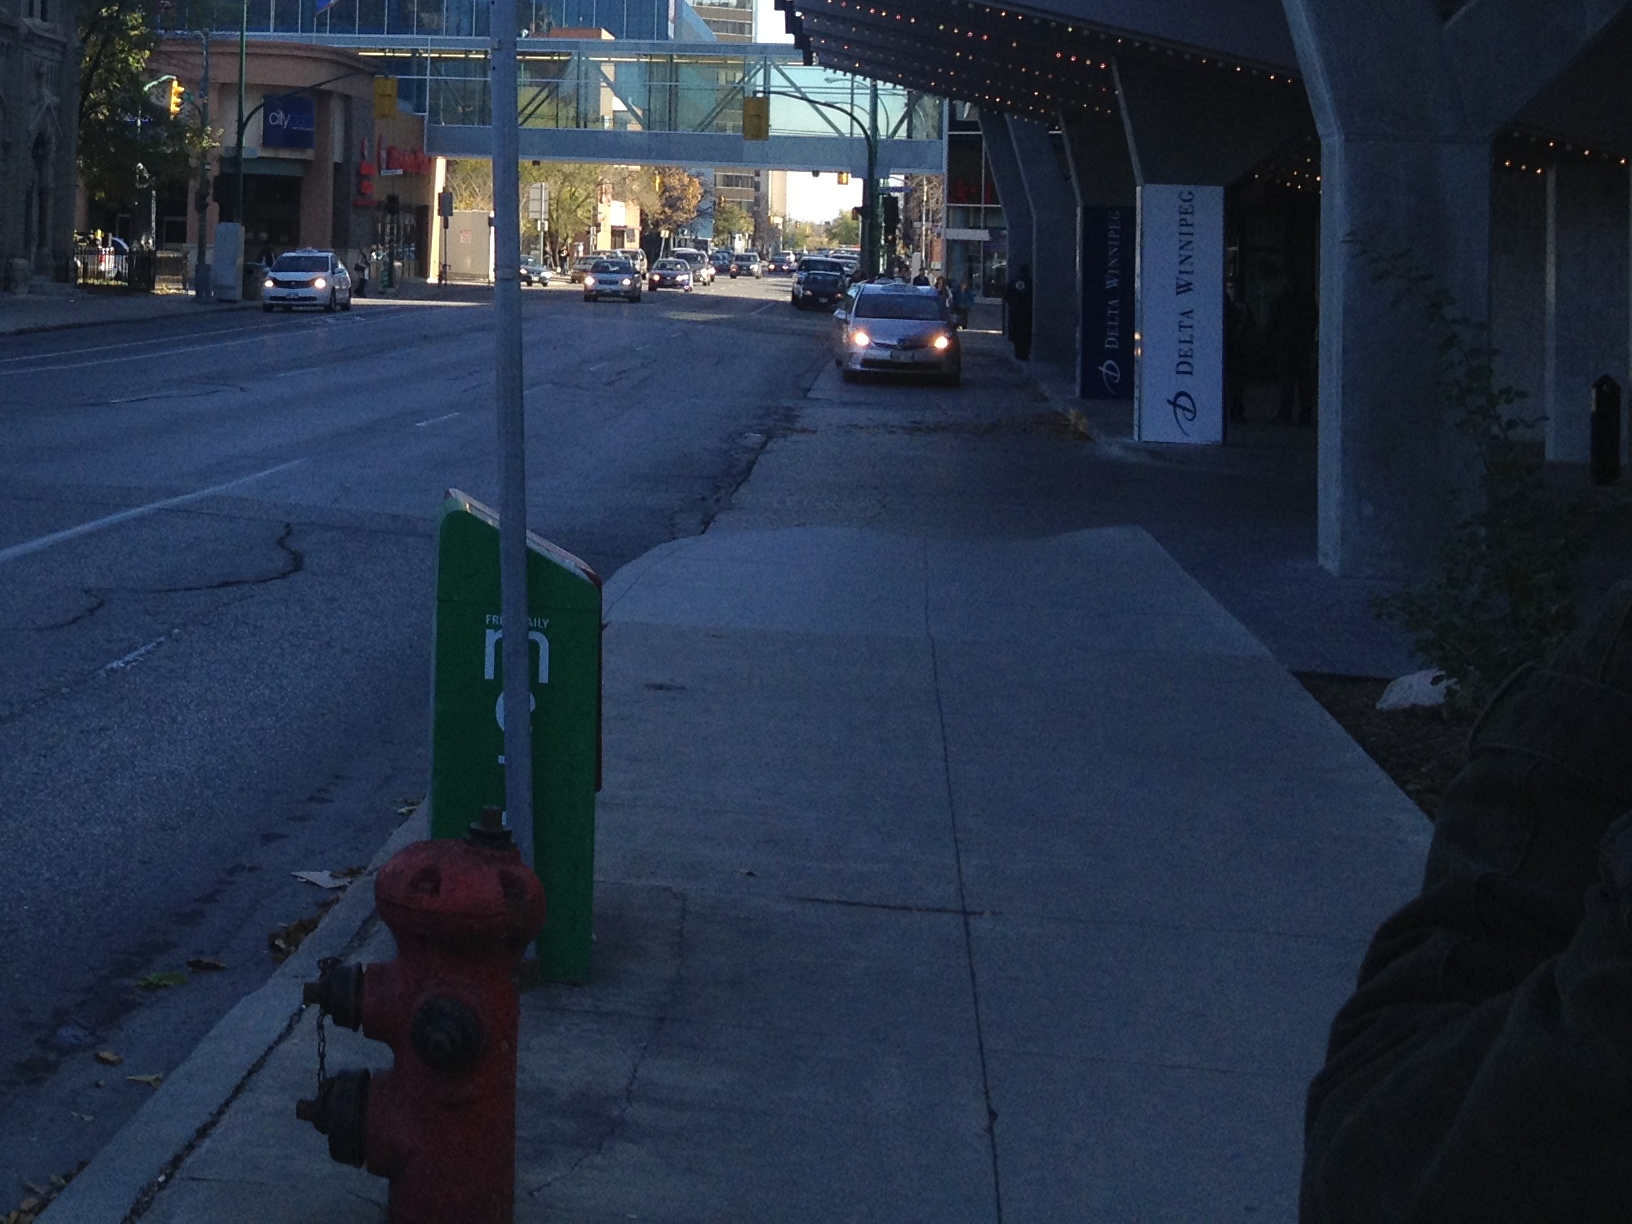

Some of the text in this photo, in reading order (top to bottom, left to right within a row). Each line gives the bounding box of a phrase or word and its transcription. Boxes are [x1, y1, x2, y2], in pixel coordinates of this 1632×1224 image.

[1104, 209, 1122, 350] DELTA WINNIPEG
[1175, 189, 1196, 376] DELTA WINNIPEG
